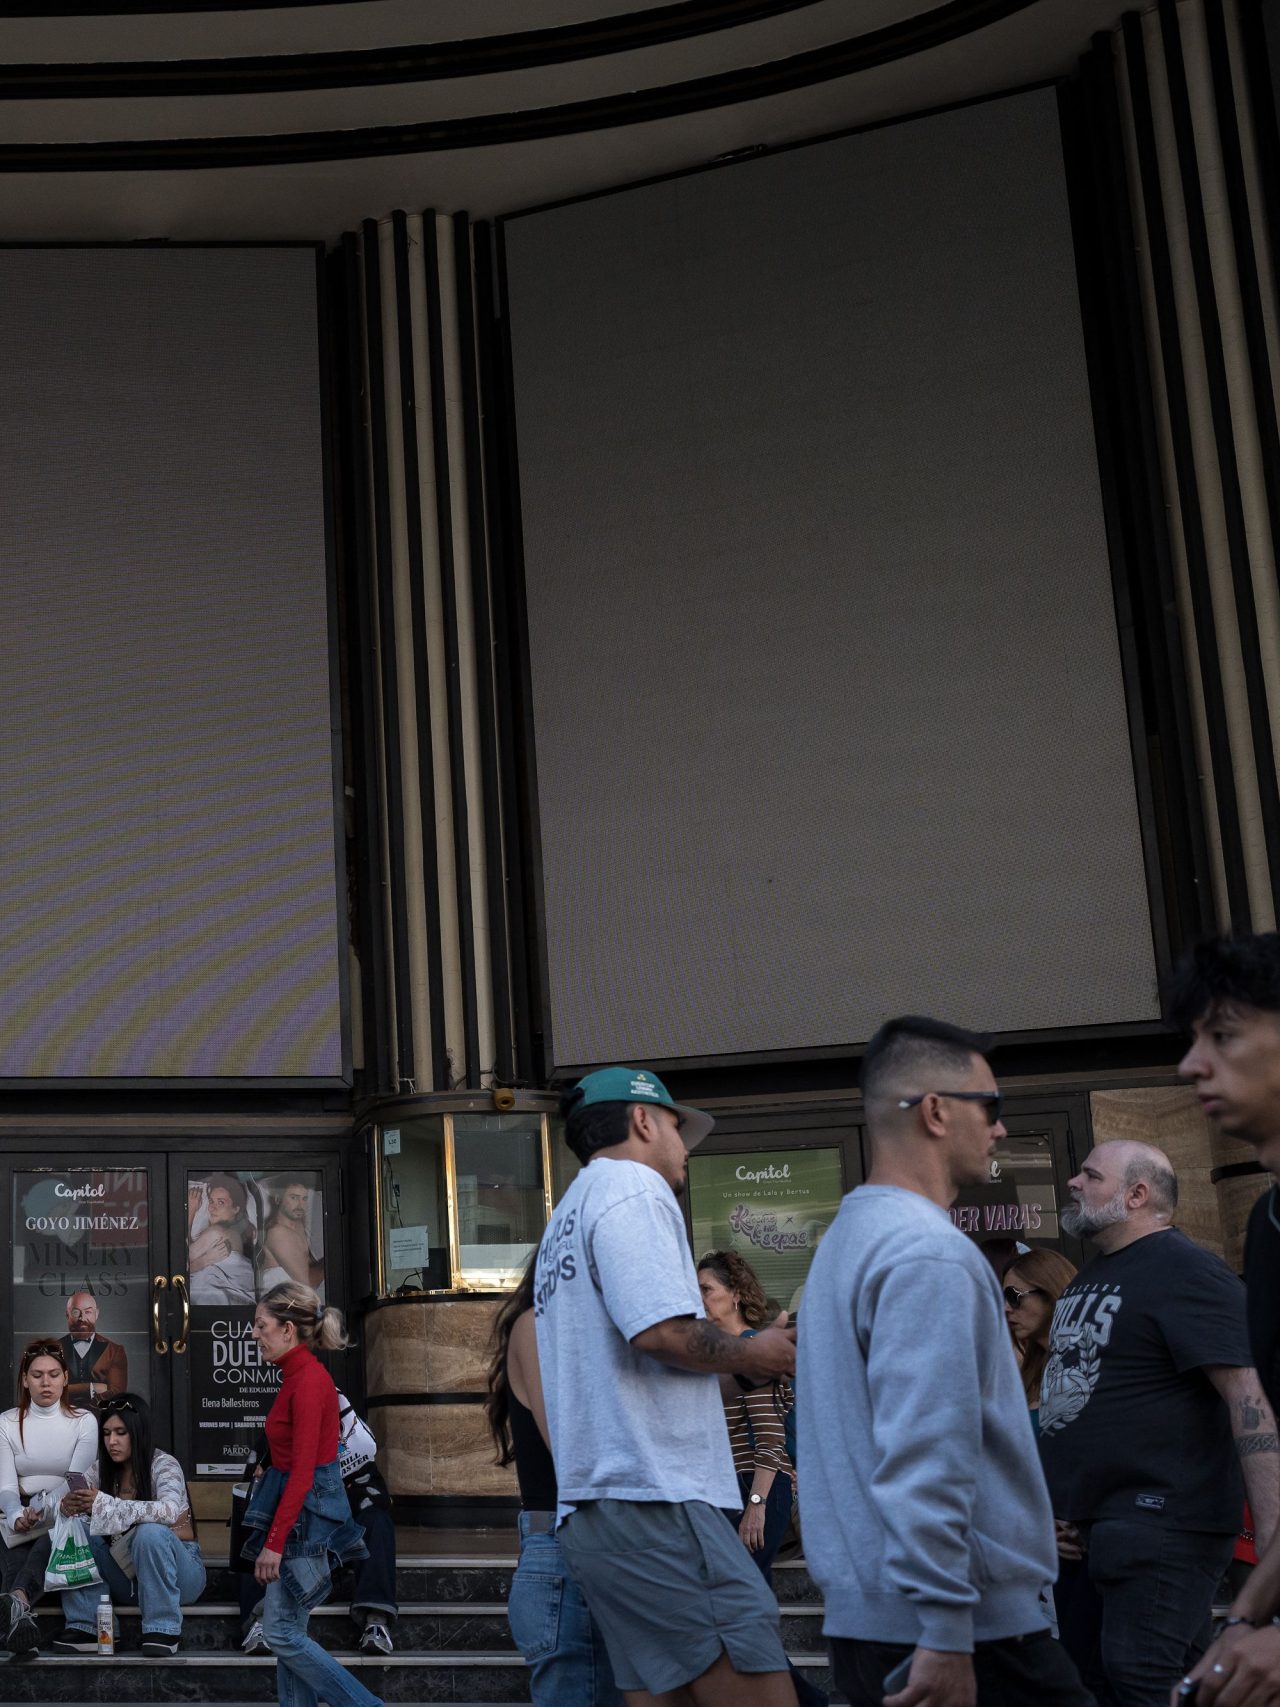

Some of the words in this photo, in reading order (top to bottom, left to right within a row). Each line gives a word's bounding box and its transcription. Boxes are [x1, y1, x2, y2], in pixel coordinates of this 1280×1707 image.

[736, 1164, 791, 1183] Capitol
[54, 1183, 106, 1200] Capitol
[25, 1216, 70, 1230] GOYO
[72, 1213, 139, 1230] JIMÉNEZ
[949, 1206, 980, 1232] DER
[983, 1203, 1042, 1231] VARAS
[28, 1242, 133, 1266] MISERY
[38, 1272, 129, 1297] CLASS
[211, 1320, 253, 1339] CUA
[201, 1397, 220, 1408] Elena
[221, 1397, 260, 1408] Ballesteros
[340, 1452, 361, 1467] RILL
[341, 1454, 369, 1476] ASTER
